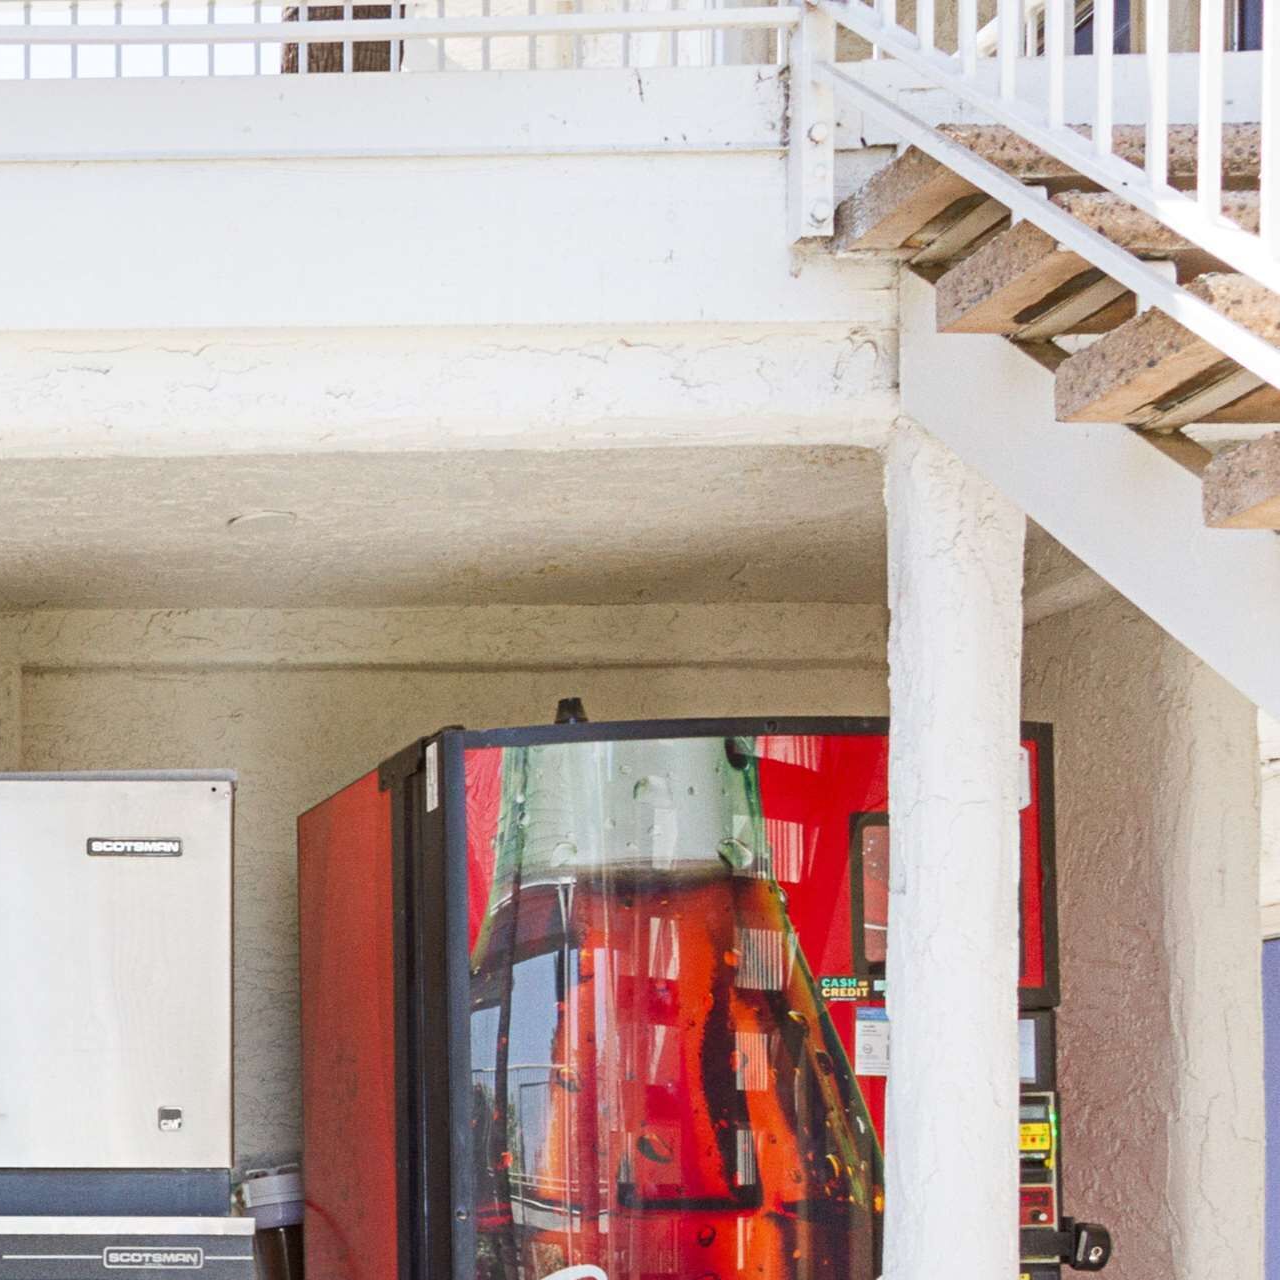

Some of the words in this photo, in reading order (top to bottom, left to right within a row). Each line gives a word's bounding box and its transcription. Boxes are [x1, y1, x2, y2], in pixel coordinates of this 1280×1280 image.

[91, 841, 179, 852] SCOTSMAN
[821, 978, 857, 987] CASH
[821, 987, 870, 997] CREDIT
[107, 1252, 197, 1264] SCOTSMAN
